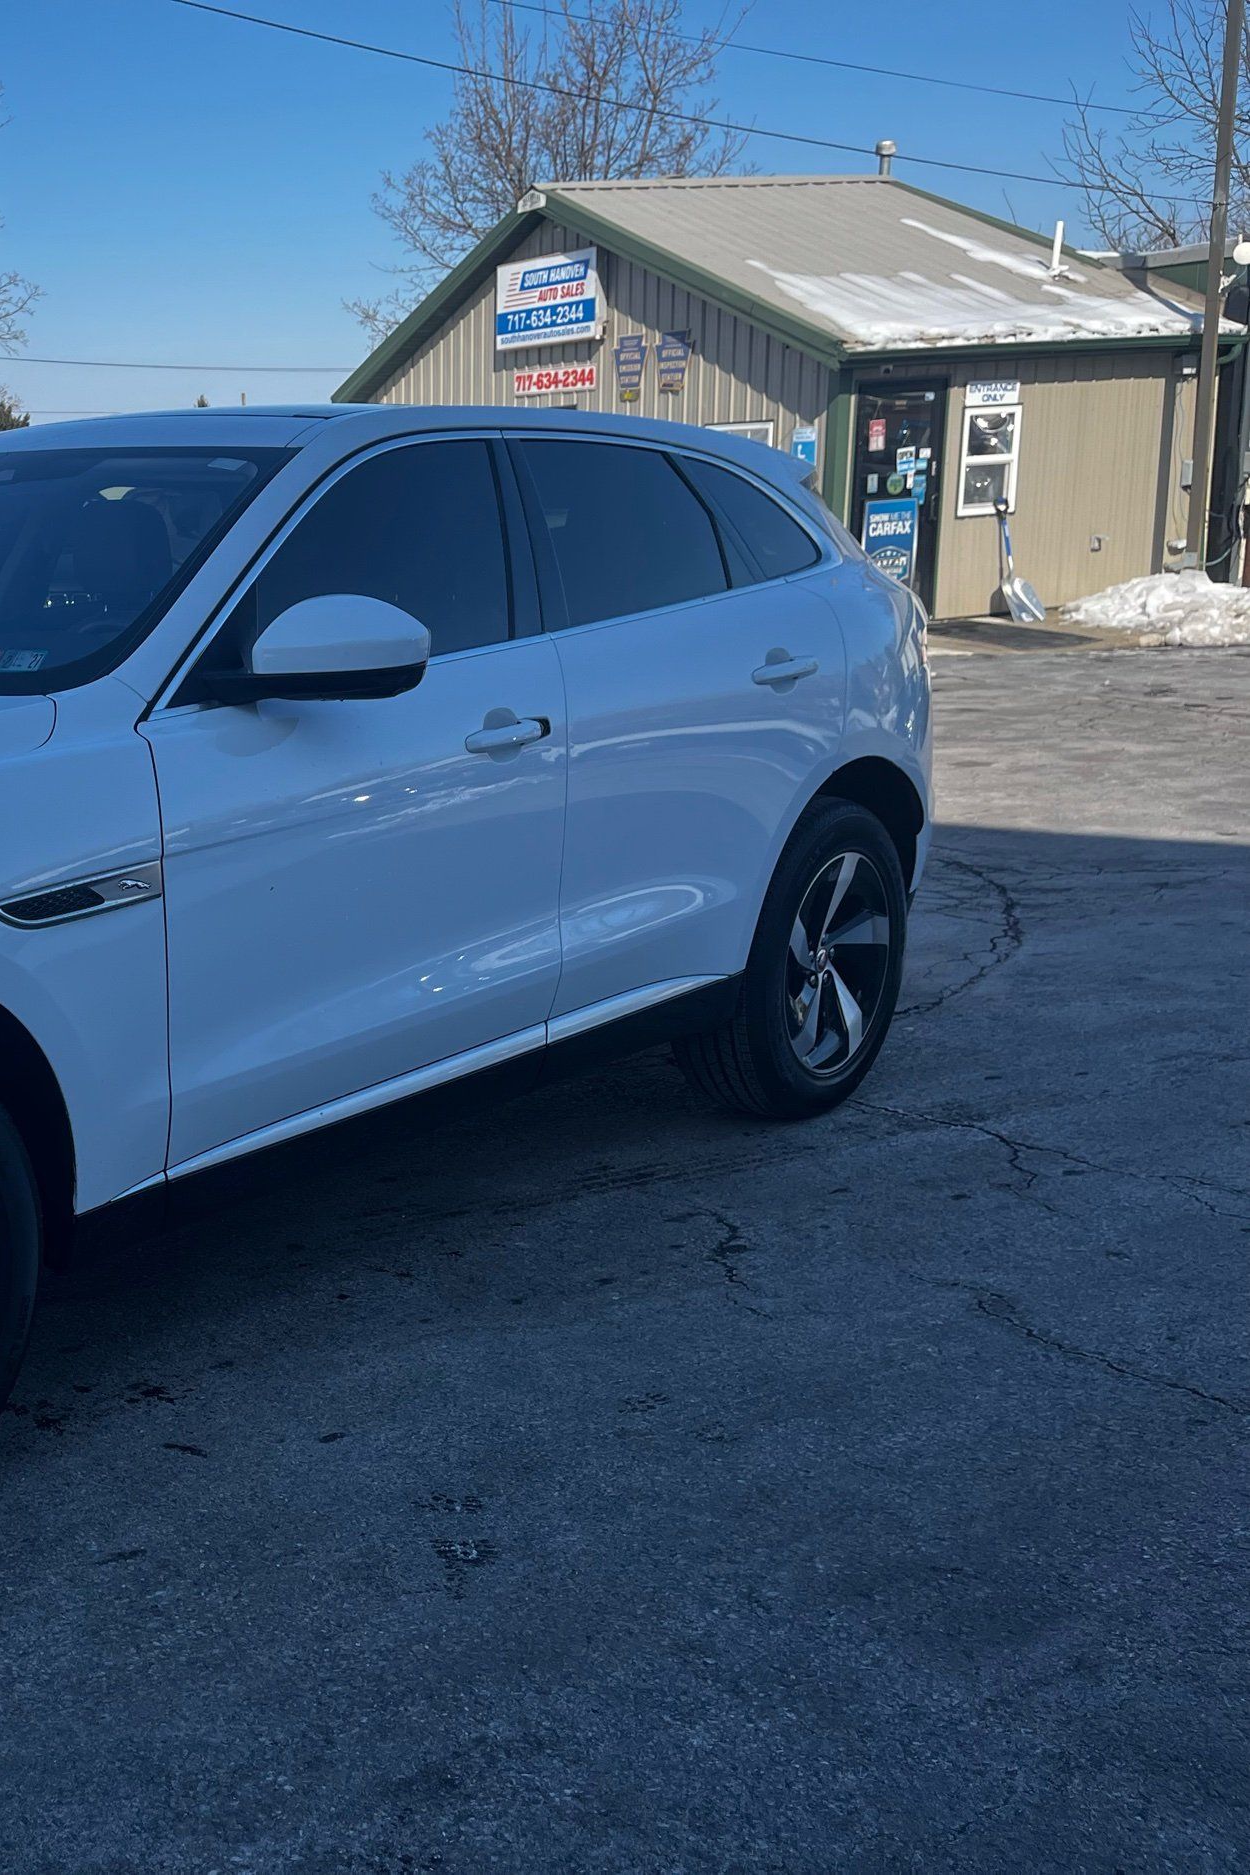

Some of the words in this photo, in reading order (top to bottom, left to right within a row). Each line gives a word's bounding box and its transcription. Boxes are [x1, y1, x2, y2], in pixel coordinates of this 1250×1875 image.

[524, 269, 548, 287] SOUTH
[549, 262, 586, 282] HANOVER
[537, 287, 558, 303] AUTO
[560, 282, 585, 298] SALES
[507, 303, 584, 331] 717-634-2344
[500, 325, 591, 345] southhanoverautosales.com
[516, 367, 595, 392] 717-634-2344
[969, 382, 1017, 393] ENTRANCE
[982, 393, 1006, 402] ONLY
[870, 513, 889, 522] SHOW
[869, 521, 912, 537] CARFAX
[28, 653, 44, 669] 27
